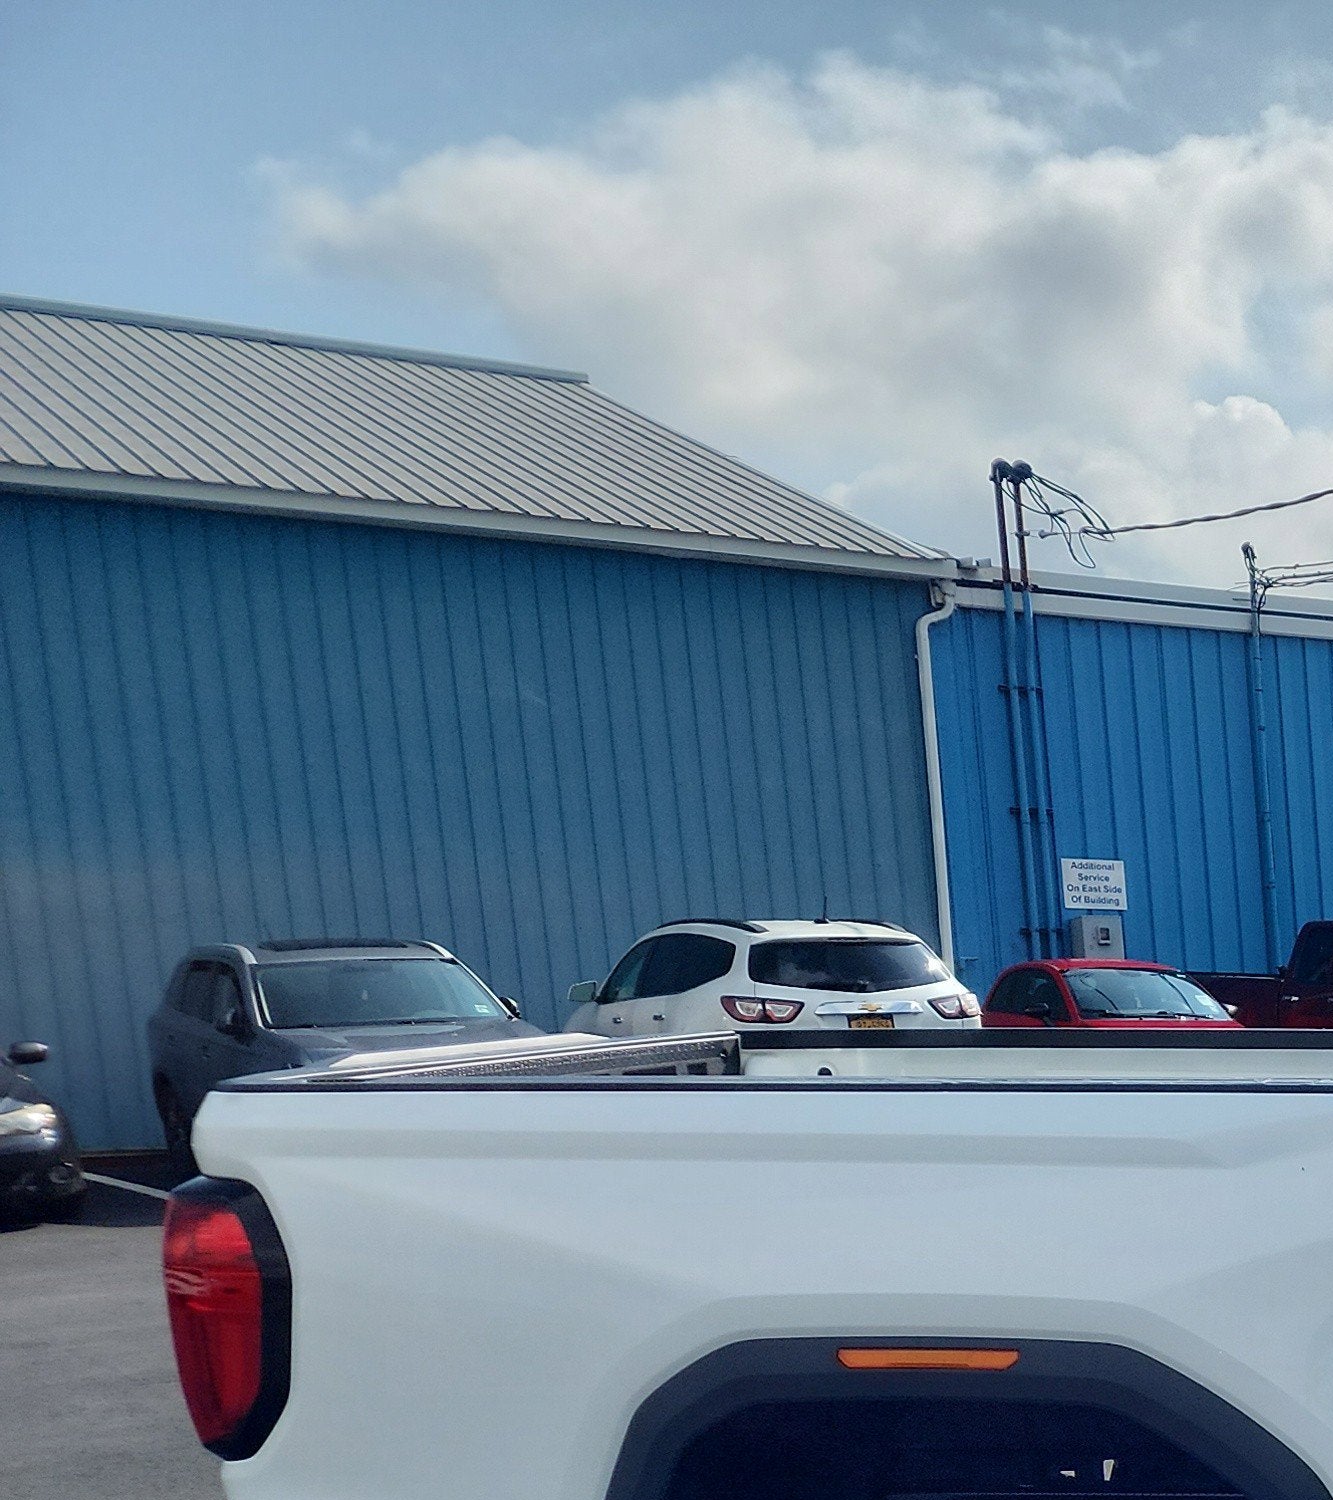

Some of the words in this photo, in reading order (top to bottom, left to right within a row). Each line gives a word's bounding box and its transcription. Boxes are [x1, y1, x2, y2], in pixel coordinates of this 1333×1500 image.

[1071, 861, 1115, 871] Additional
[1078, 873, 1110, 882] Service
[1082, 884, 1101, 893] East
[1103, 885, 1122, 893] Side
[1071, 895, 1081, 903] Of
[1084, 896, 1120, 906] Building
